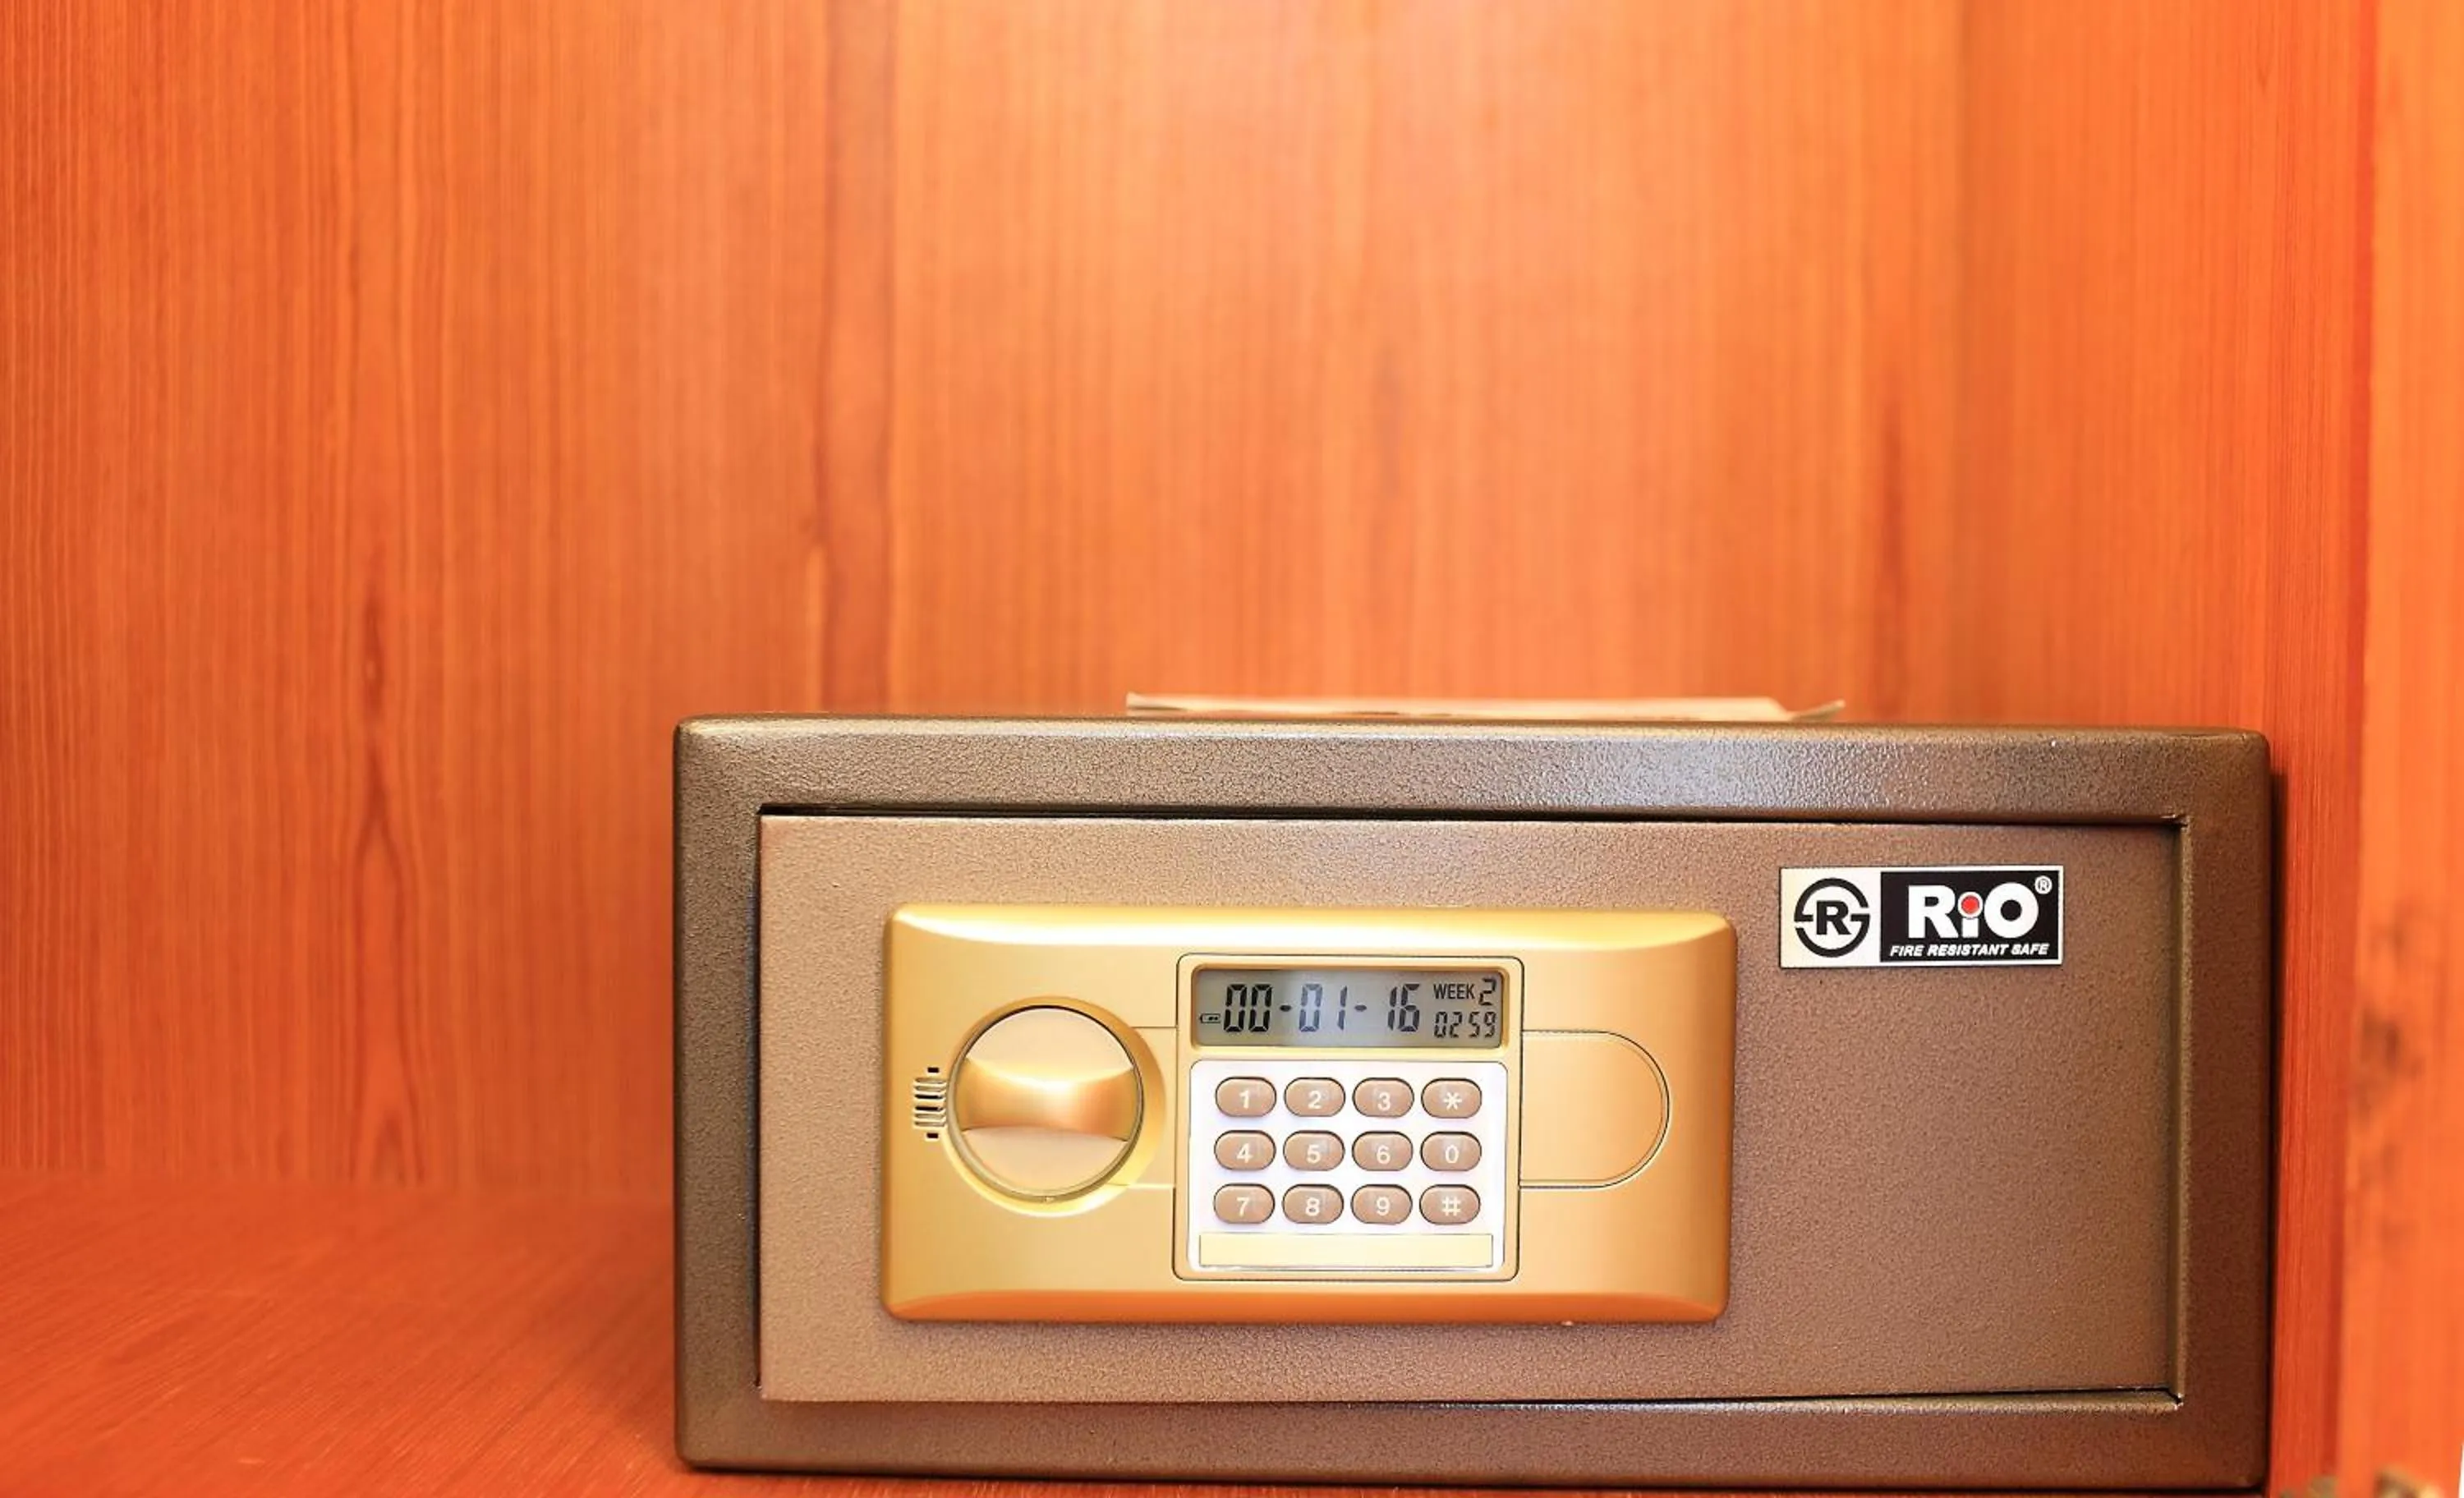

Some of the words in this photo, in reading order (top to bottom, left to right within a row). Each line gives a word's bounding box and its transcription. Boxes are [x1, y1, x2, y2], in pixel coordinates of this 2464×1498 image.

[1890, 944, 1922, 957] FIRE
[1927, 944, 2007, 957] RESISTANT
[2011, 943, 2050, 956] SAFE
[1433, 984, 1475, 999] WEEK
[1479, 978, 1497, 1006] 2
[1239, 1090, 1250, 1109] 1
[1308, 1091, 1322, 1110] 2
[1377, 1091, 1391, 1110] 3
[1236, 1143, 1252, 1164] 4
[1306, 1144, 1321, 1164] 5
[1376, 1145, 1391, 1164] 6
[1445, 1144, 1460, 1164] 0
[1236, 1197, 1250, 1215] 7
[1305, 1197, 1321, 1216] 8
[1375, 1197, 1391, 1216] 9
